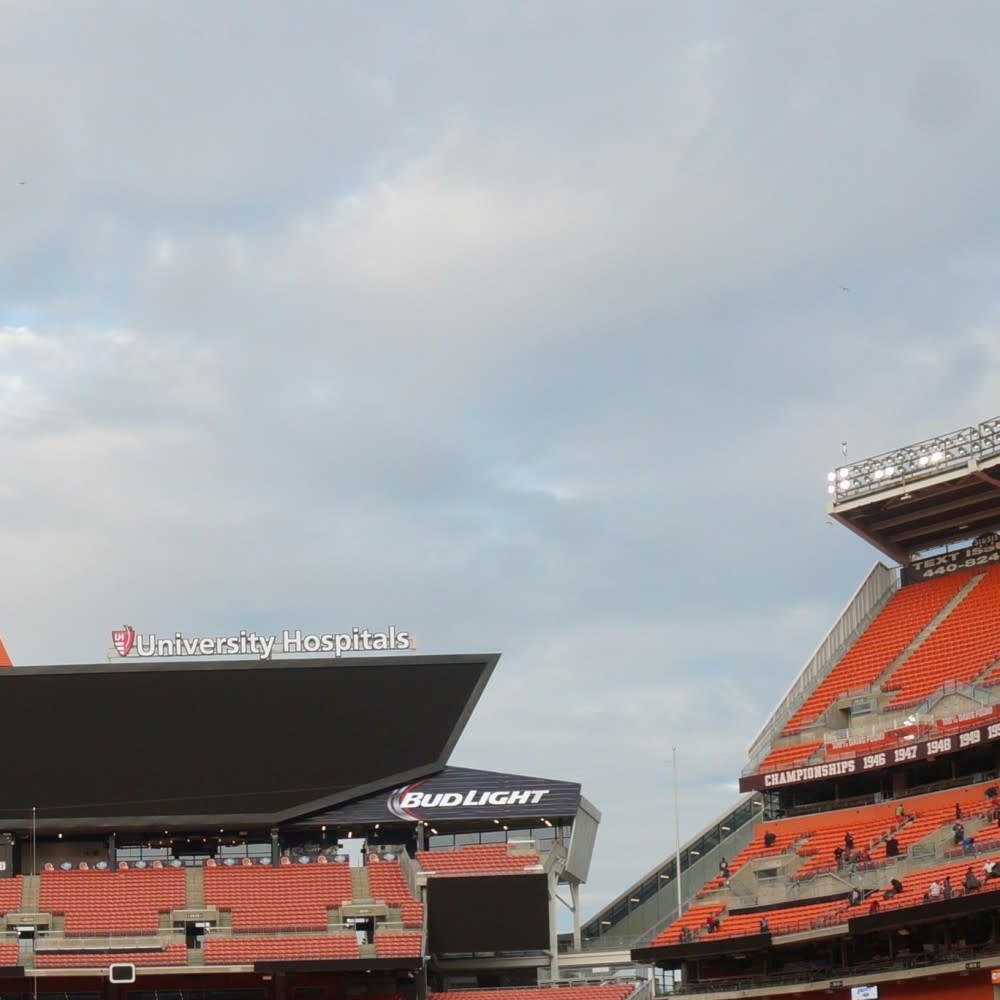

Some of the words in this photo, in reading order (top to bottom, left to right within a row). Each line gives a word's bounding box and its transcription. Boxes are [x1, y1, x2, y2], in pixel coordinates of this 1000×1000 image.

[912, 552, 960, 570] TEXT
[137, 631, 275, 661] University
[282, 626, 410, 658] Hospitals
[765, 759, 856, 787] CHAMPIONSHIPS
[863, 753, 886, 769] 1946
[894, 746, 917, 763] 1947
[926, 738, 951, 755] 1948
[959, 730, 981, 747] 1949
